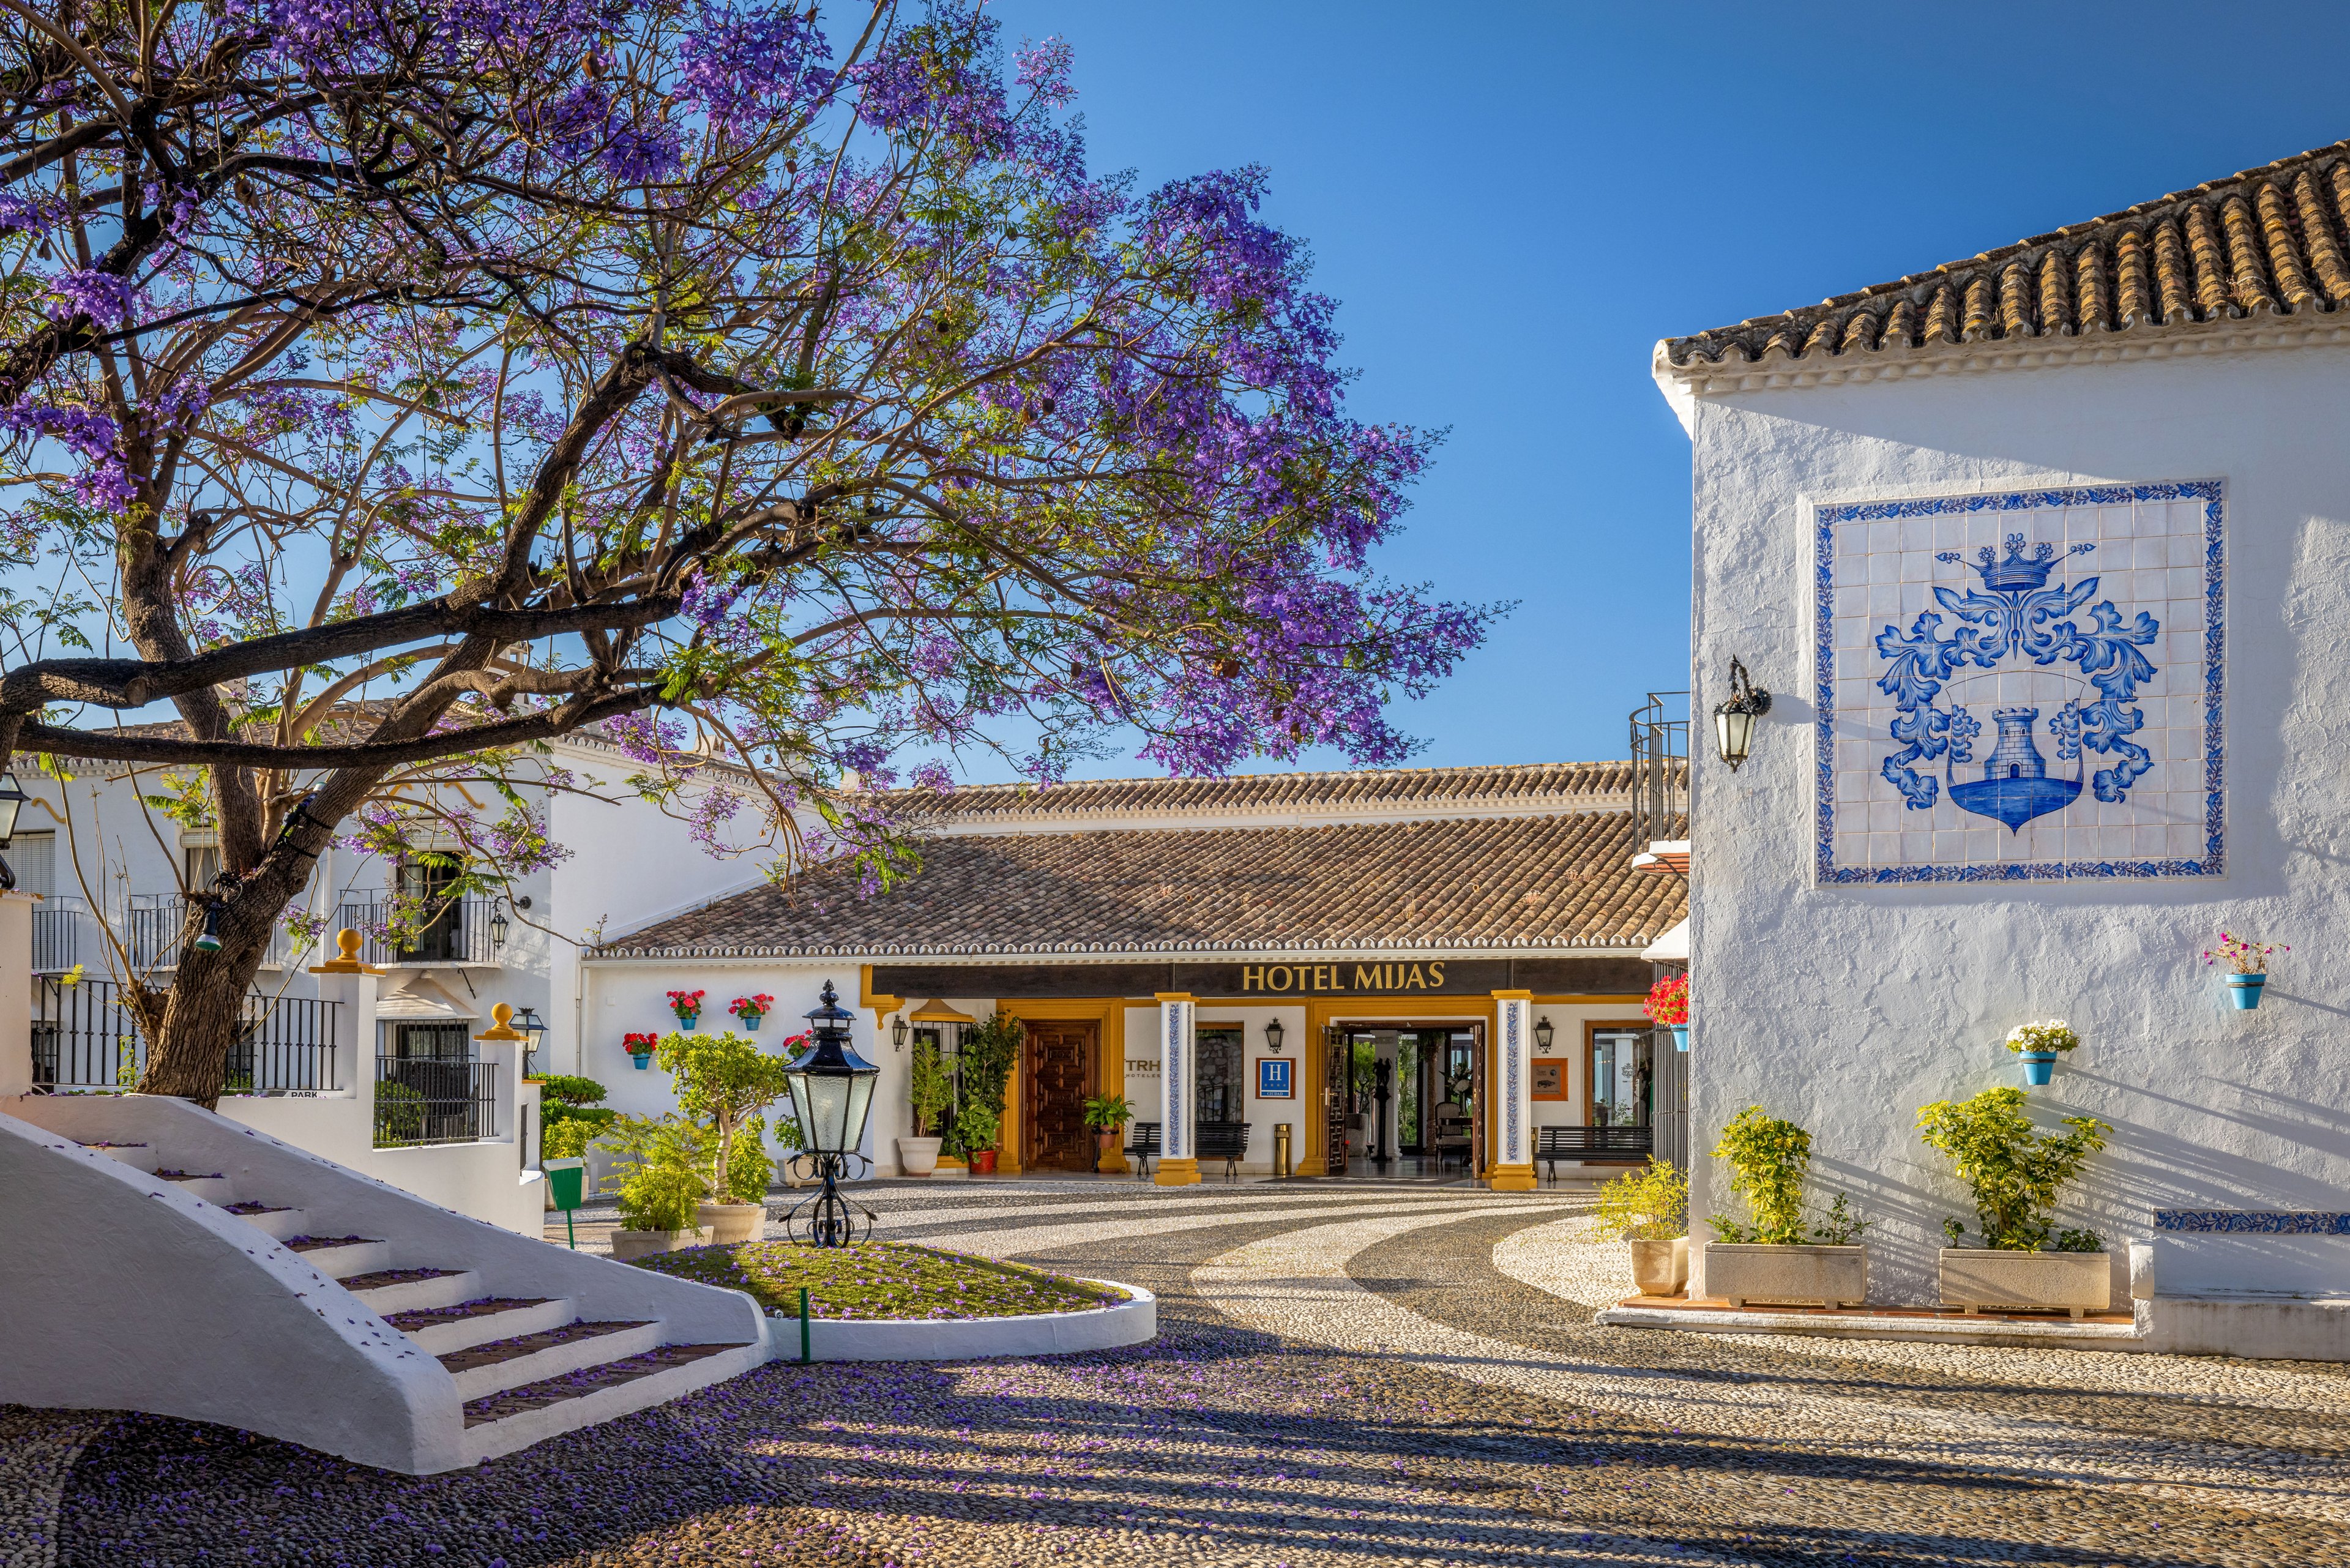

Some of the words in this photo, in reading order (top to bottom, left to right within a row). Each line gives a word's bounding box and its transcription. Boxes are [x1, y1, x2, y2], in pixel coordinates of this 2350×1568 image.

[1243, 965, 1345, 991] HOTEL
[1354, 961, 1445, 990] MIJAS
[1125, 1060, 1161, 1071] TRH
[1268, 1064, 1282, 1081] H
